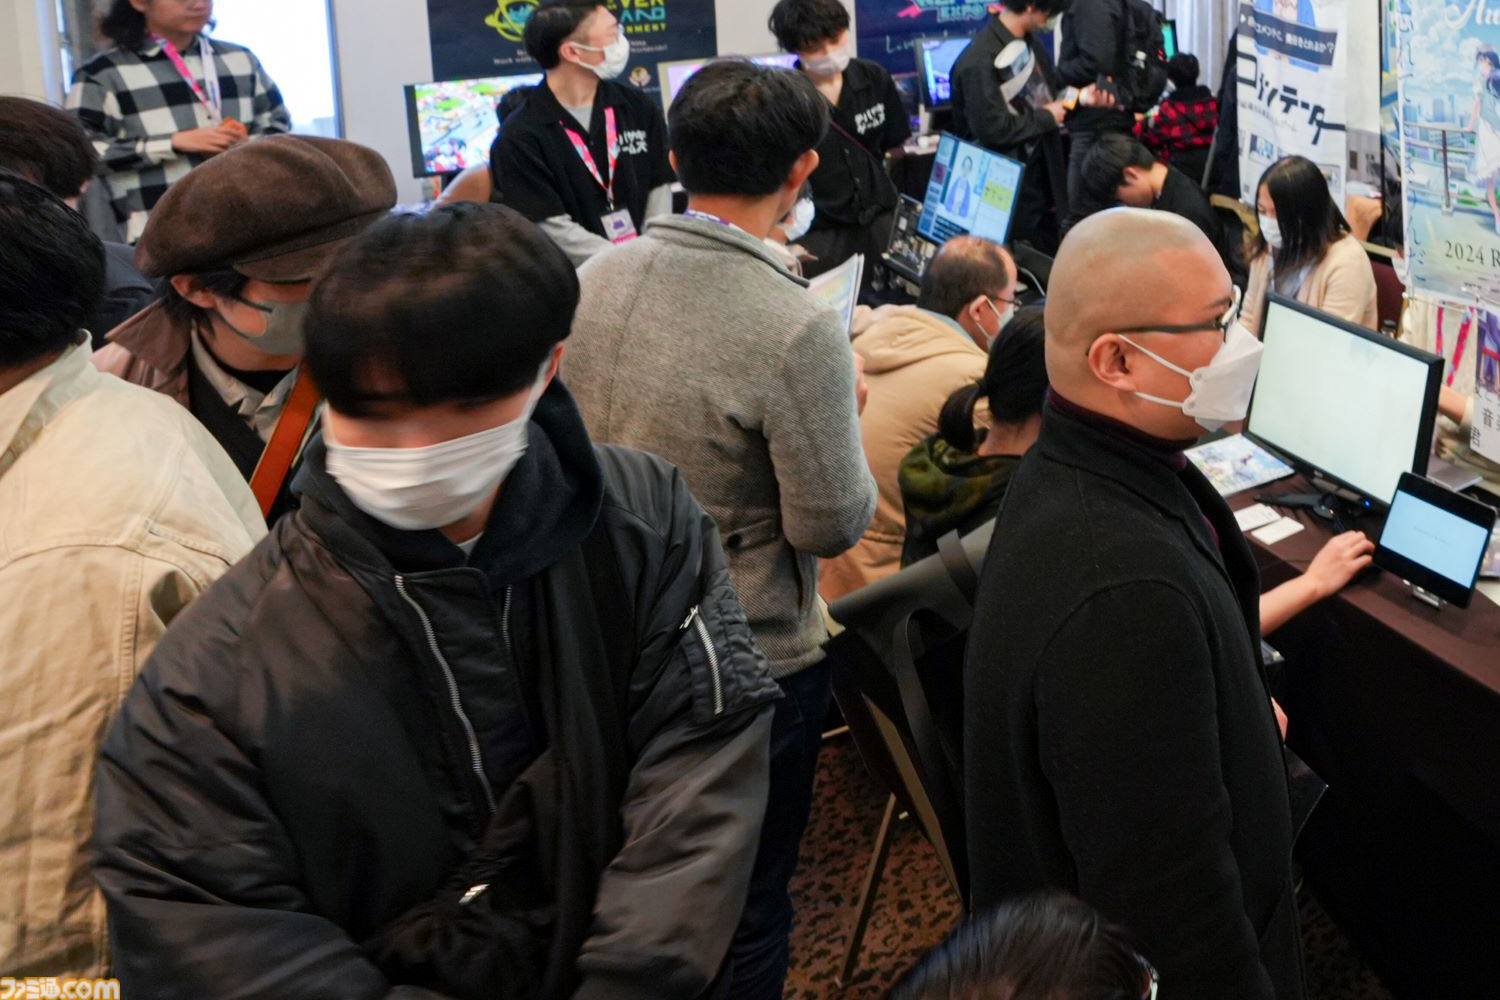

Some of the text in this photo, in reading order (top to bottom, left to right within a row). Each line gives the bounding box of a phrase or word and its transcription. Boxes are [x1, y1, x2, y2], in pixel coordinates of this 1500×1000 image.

[620, 7, 667, 23] AND
[937, 4, 986, 23] EXPO
[1445, 240, 1485, 266] 2024
